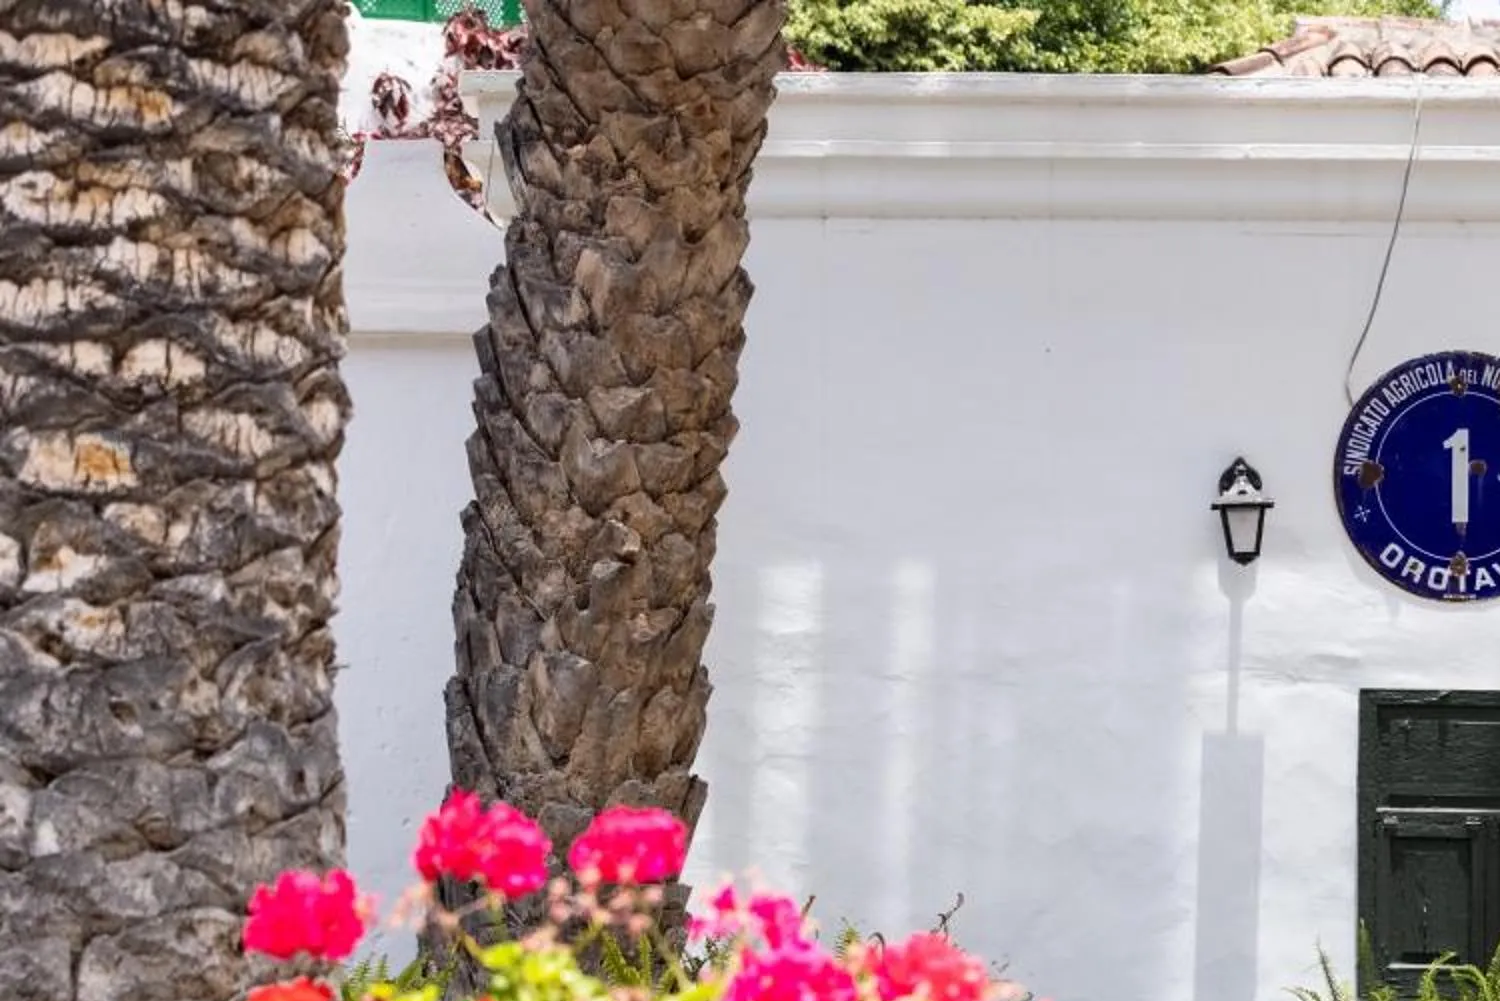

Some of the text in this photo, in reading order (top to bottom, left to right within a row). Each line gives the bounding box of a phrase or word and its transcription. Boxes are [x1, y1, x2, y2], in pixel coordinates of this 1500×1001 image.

[1344, 398, 1391, 475] SINDICATO
[1381, 360, 1457, 408] AGRICOLA
[1442, 428, 1469, 522] 1
